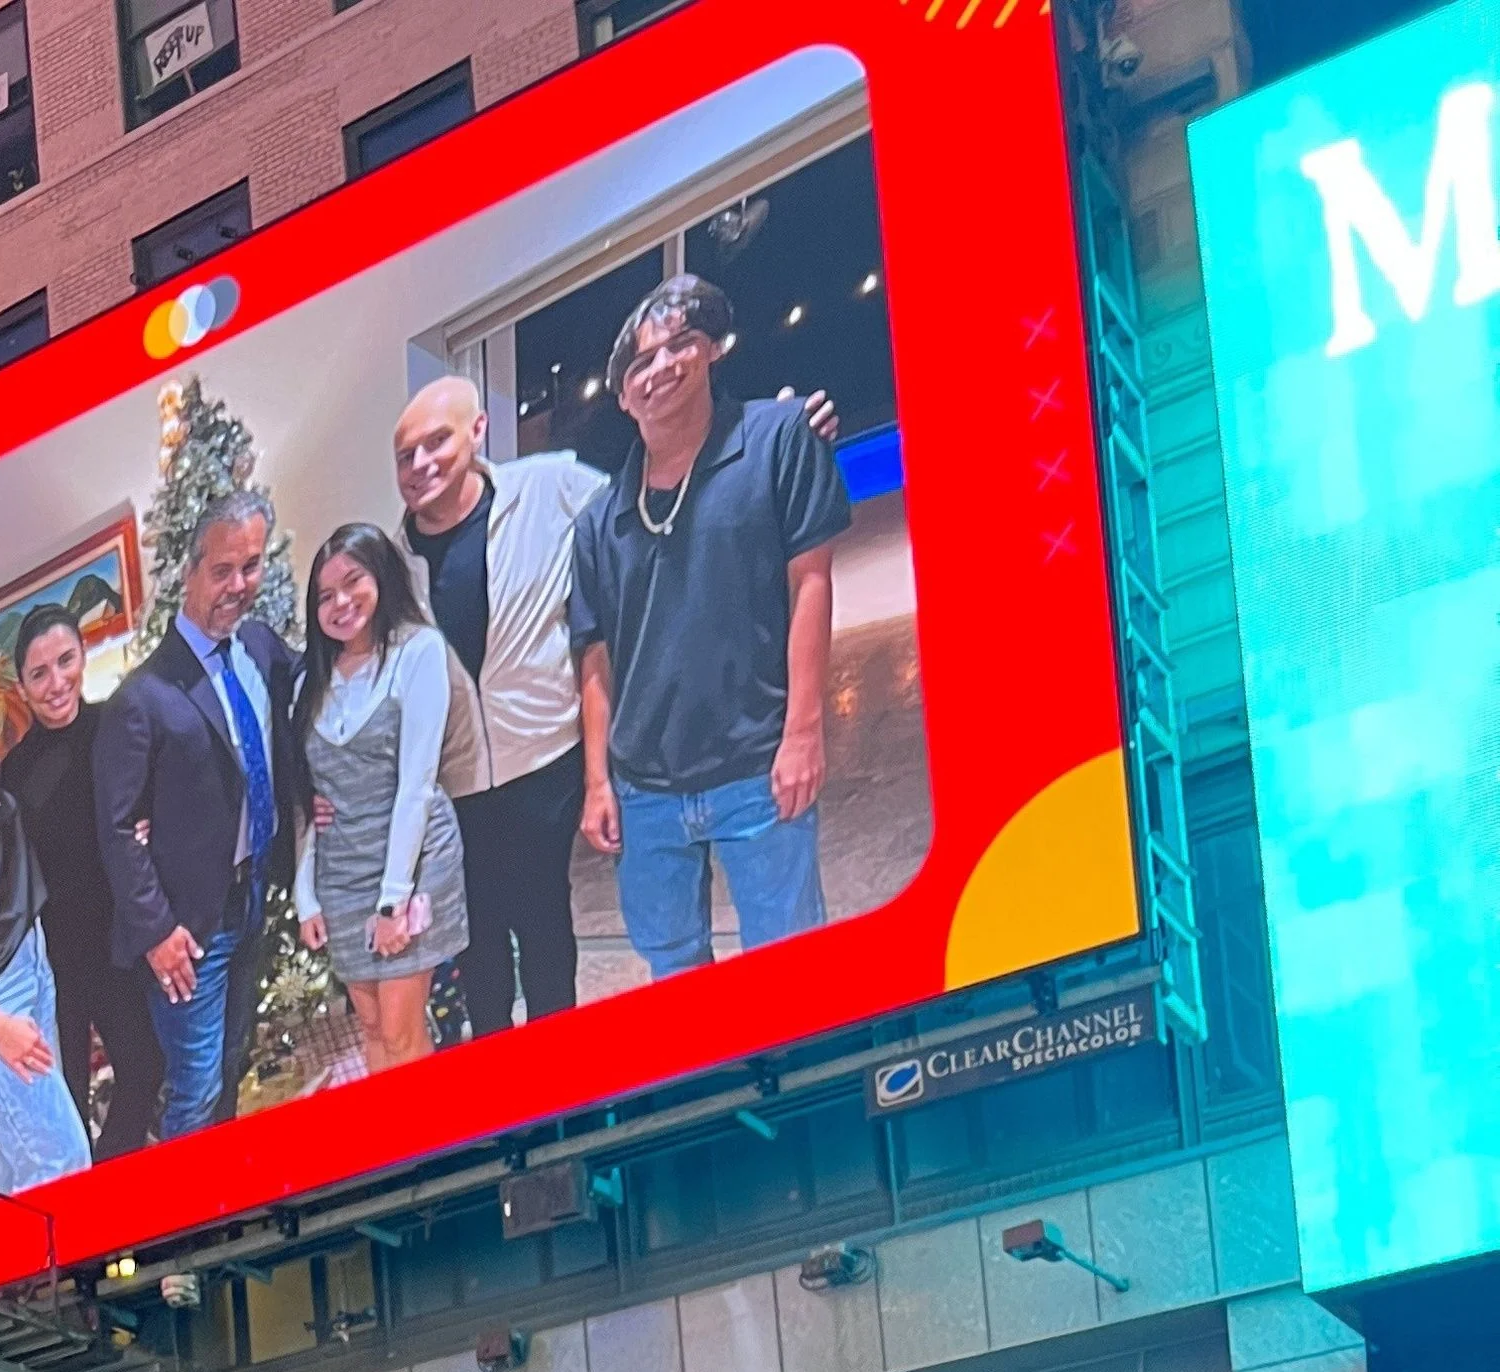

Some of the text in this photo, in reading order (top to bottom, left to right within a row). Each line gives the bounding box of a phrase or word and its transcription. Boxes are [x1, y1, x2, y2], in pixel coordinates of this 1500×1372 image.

[185, 24, 205, 46] UP
[1300, 83, 1500, 357] M
[1012, 1023, 1141, 1071] SPECTACOLOR
